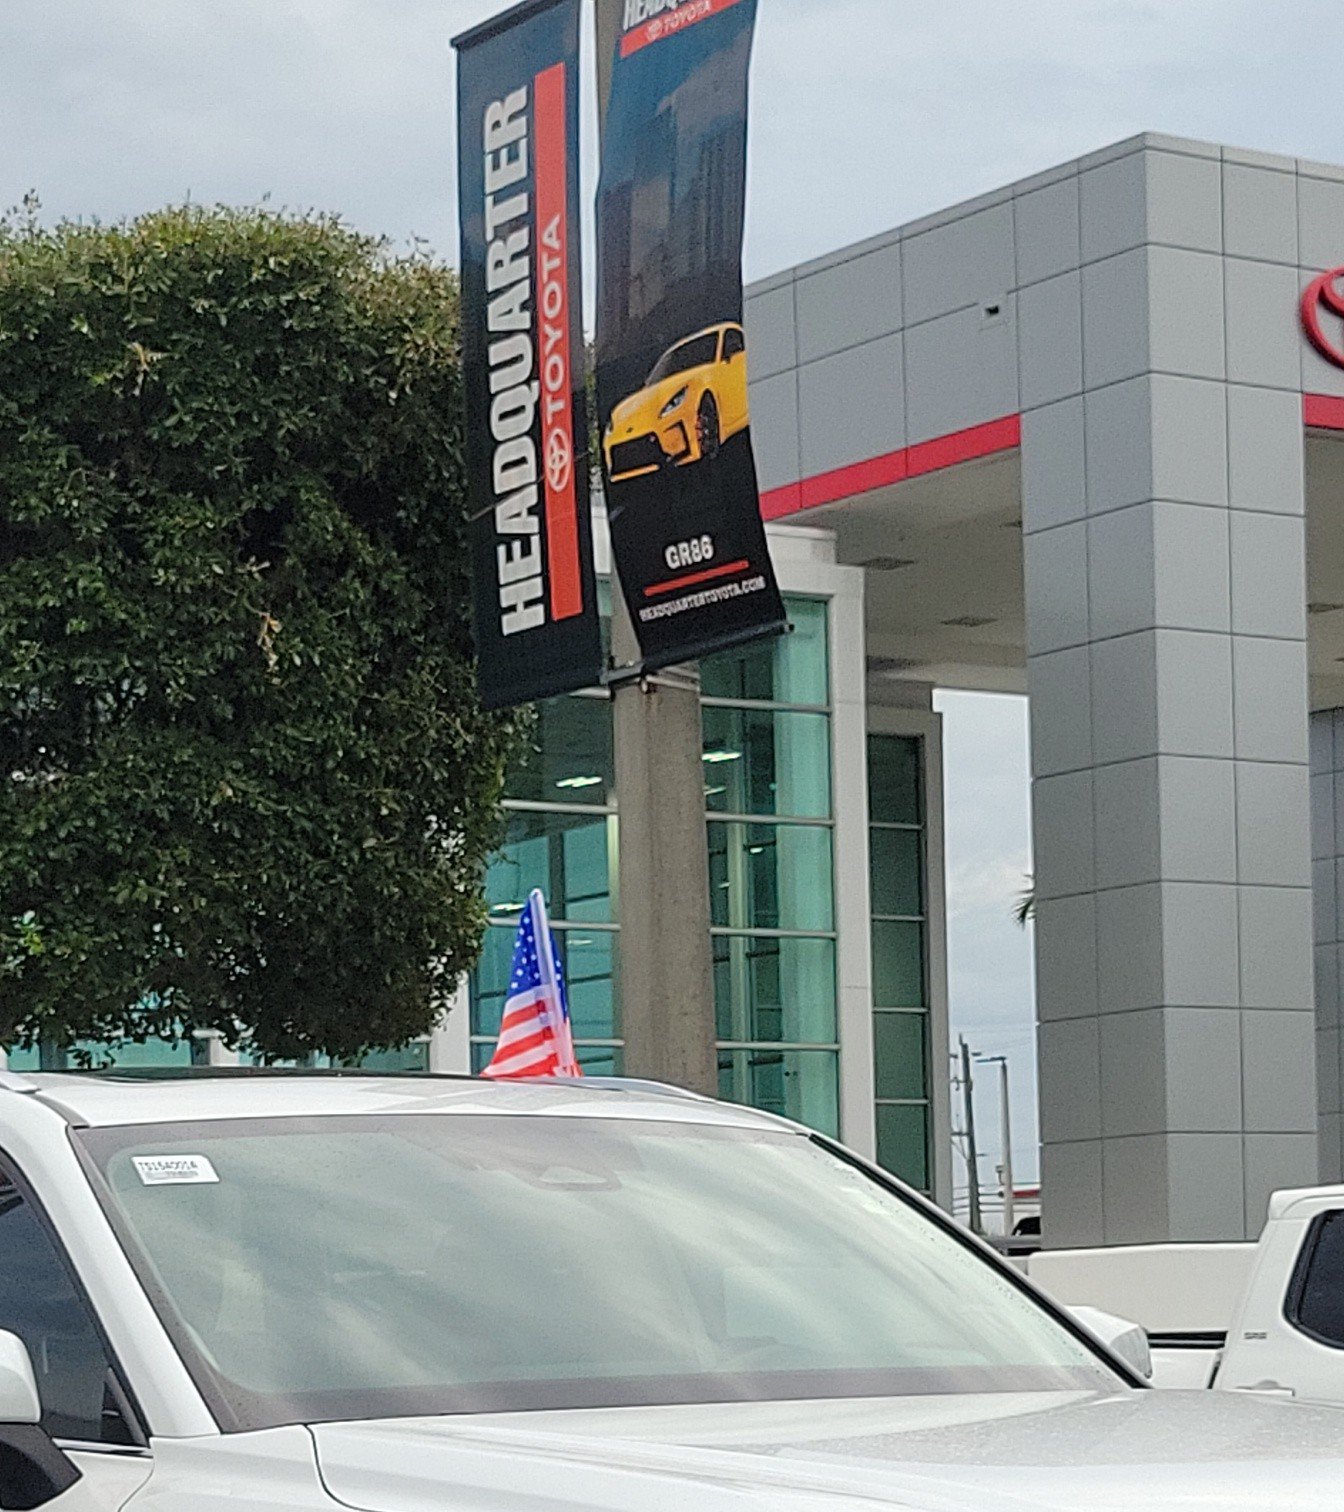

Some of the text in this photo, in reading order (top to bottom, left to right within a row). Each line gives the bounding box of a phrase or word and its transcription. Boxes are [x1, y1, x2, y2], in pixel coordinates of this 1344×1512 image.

[483, 84, 545, 636] HEADQUARTER
[543, 214, 564, 418] TOYOTA
[665, 535, 714, 569] GR86
